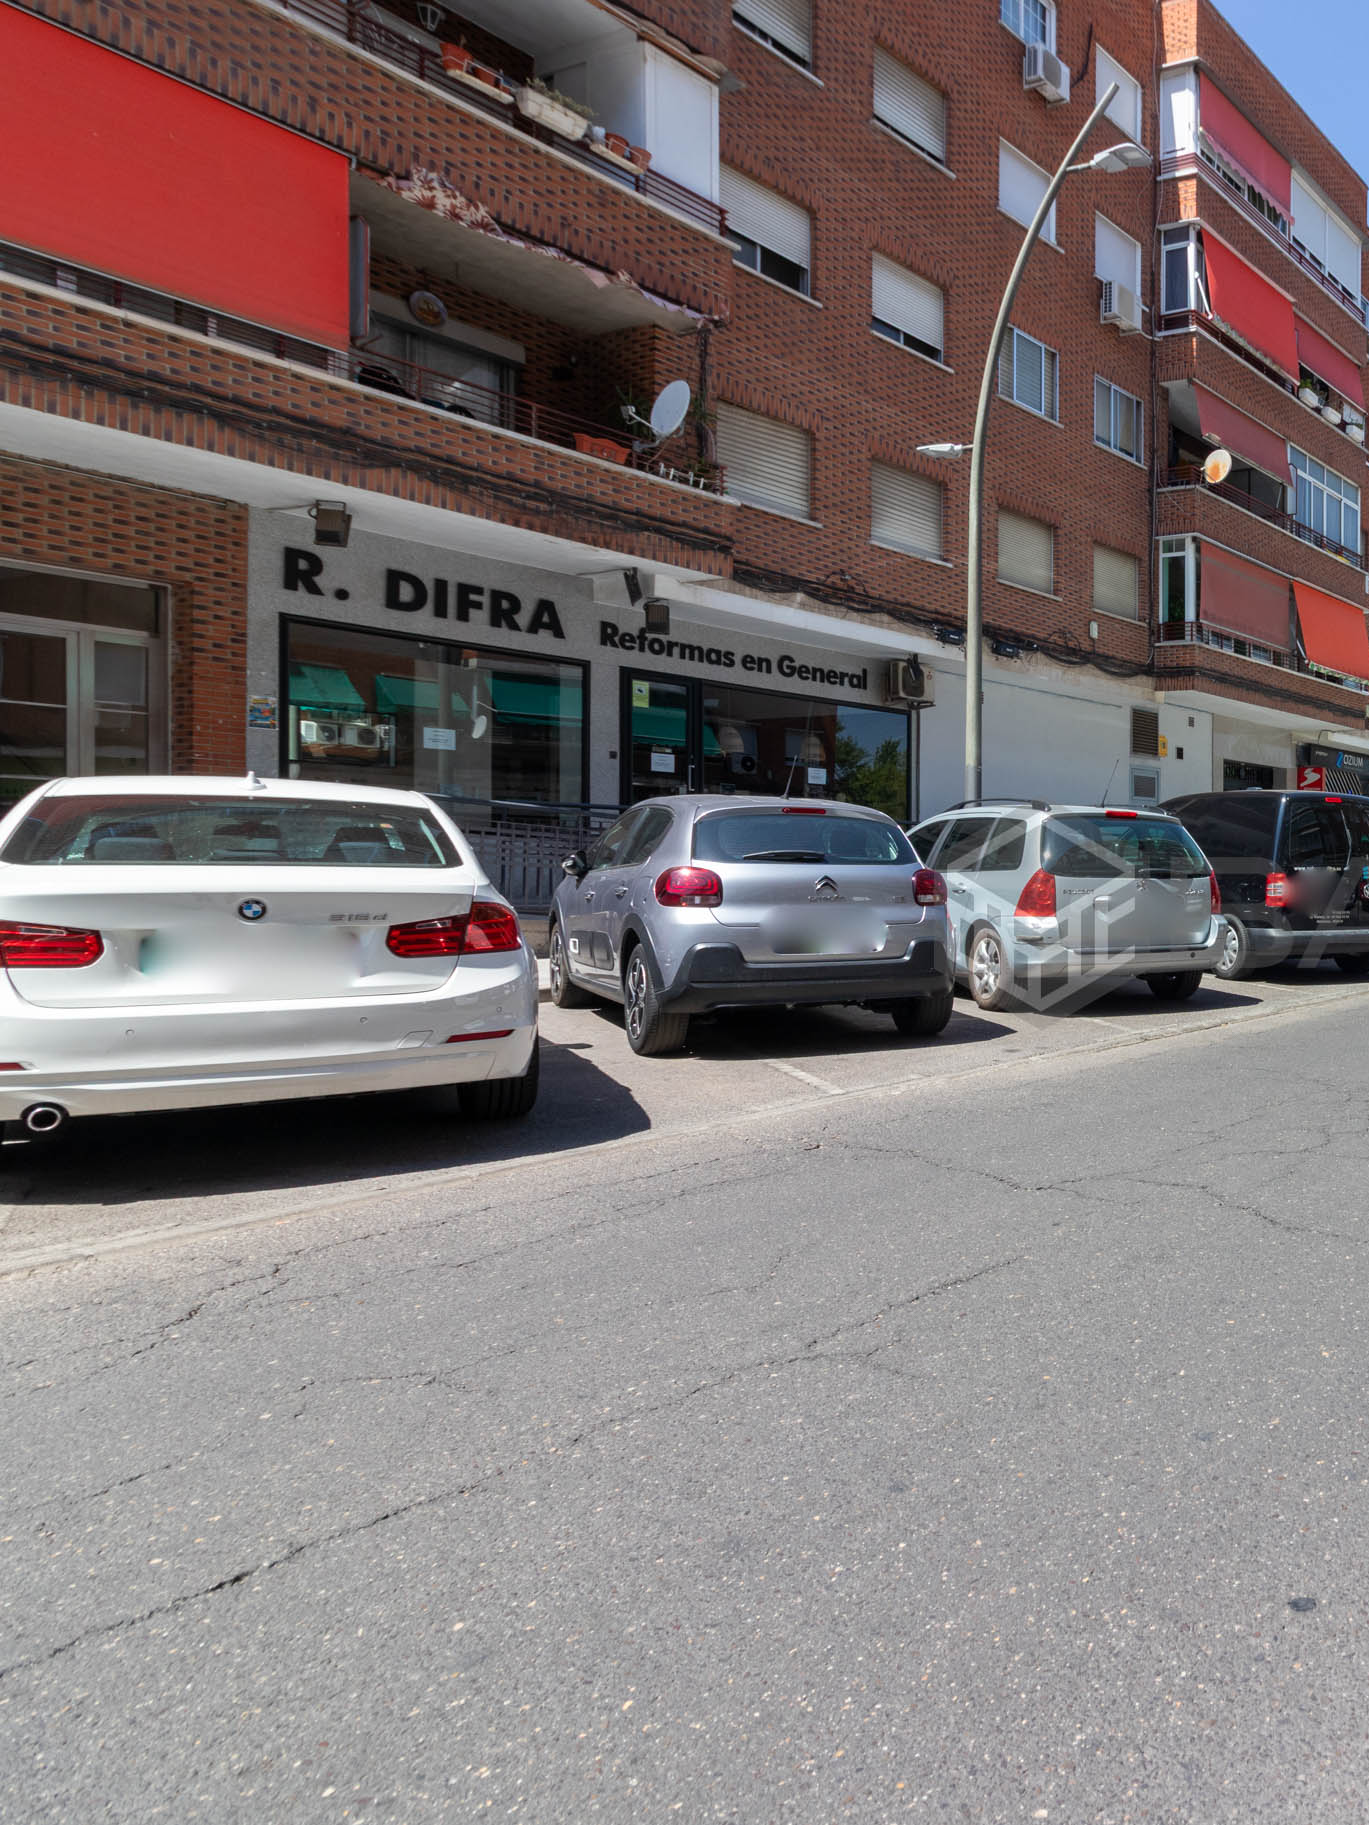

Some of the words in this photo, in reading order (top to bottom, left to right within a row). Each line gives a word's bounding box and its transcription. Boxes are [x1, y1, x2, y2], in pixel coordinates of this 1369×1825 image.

[283, 546, 350, 601] R.
[385, 561, 566, 639] DIFRA
[600, 620, 736, 668] Reformas
[741, 653, 773, 675] en
[777, 655, 868, 690] General
